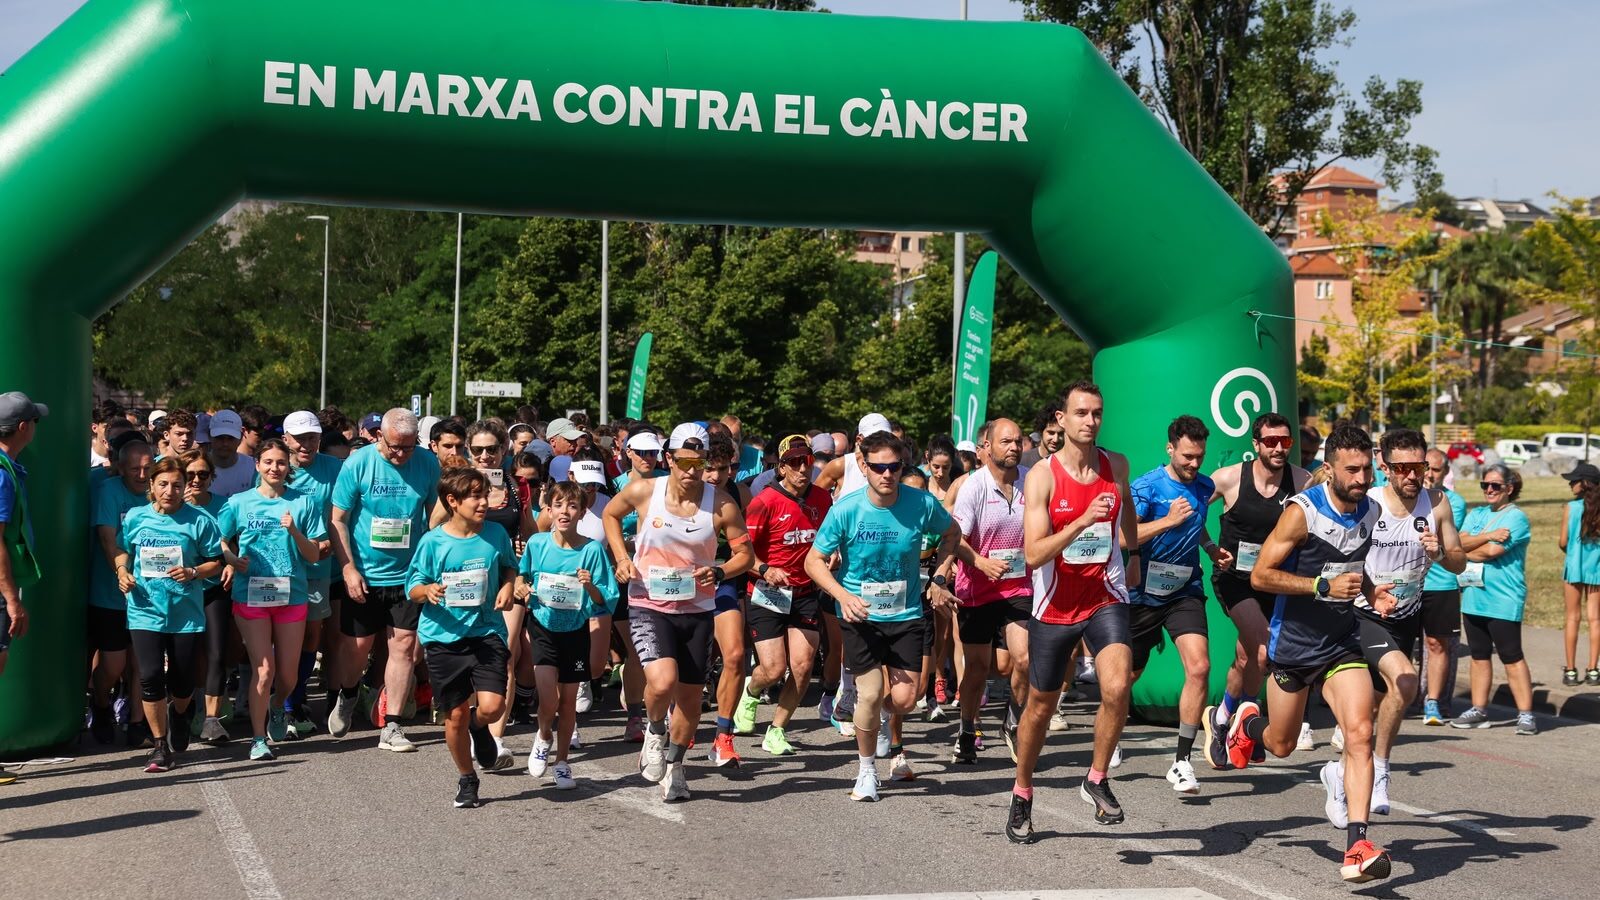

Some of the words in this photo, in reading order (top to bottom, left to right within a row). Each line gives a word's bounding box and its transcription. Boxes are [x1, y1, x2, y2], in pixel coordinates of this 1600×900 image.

[263, 60, 337, 108] EN
[353, 67, 542, 121] MARXA
[552, 82, 763, 133] CONTRA
[774, 93, 830, 136] EL
[839, 88, 1029, 142] CÀNCER
[373, 485, 389, 495] KM
[247, 520, 265, 529] KM
[857, 530, 877, 541] KM
[140, 538, 157, 548] KM
[1371, 538, 1409, 549] Ripollet
[1080, 548, 1097, 557] 209
[156, 565, 166, 573] 50
[1160, 583, 1175, 591] 507
[460, 592, 475, 601] 558
[551, 595, 566, 604] 557
[877, 602, 892, 610] 296
